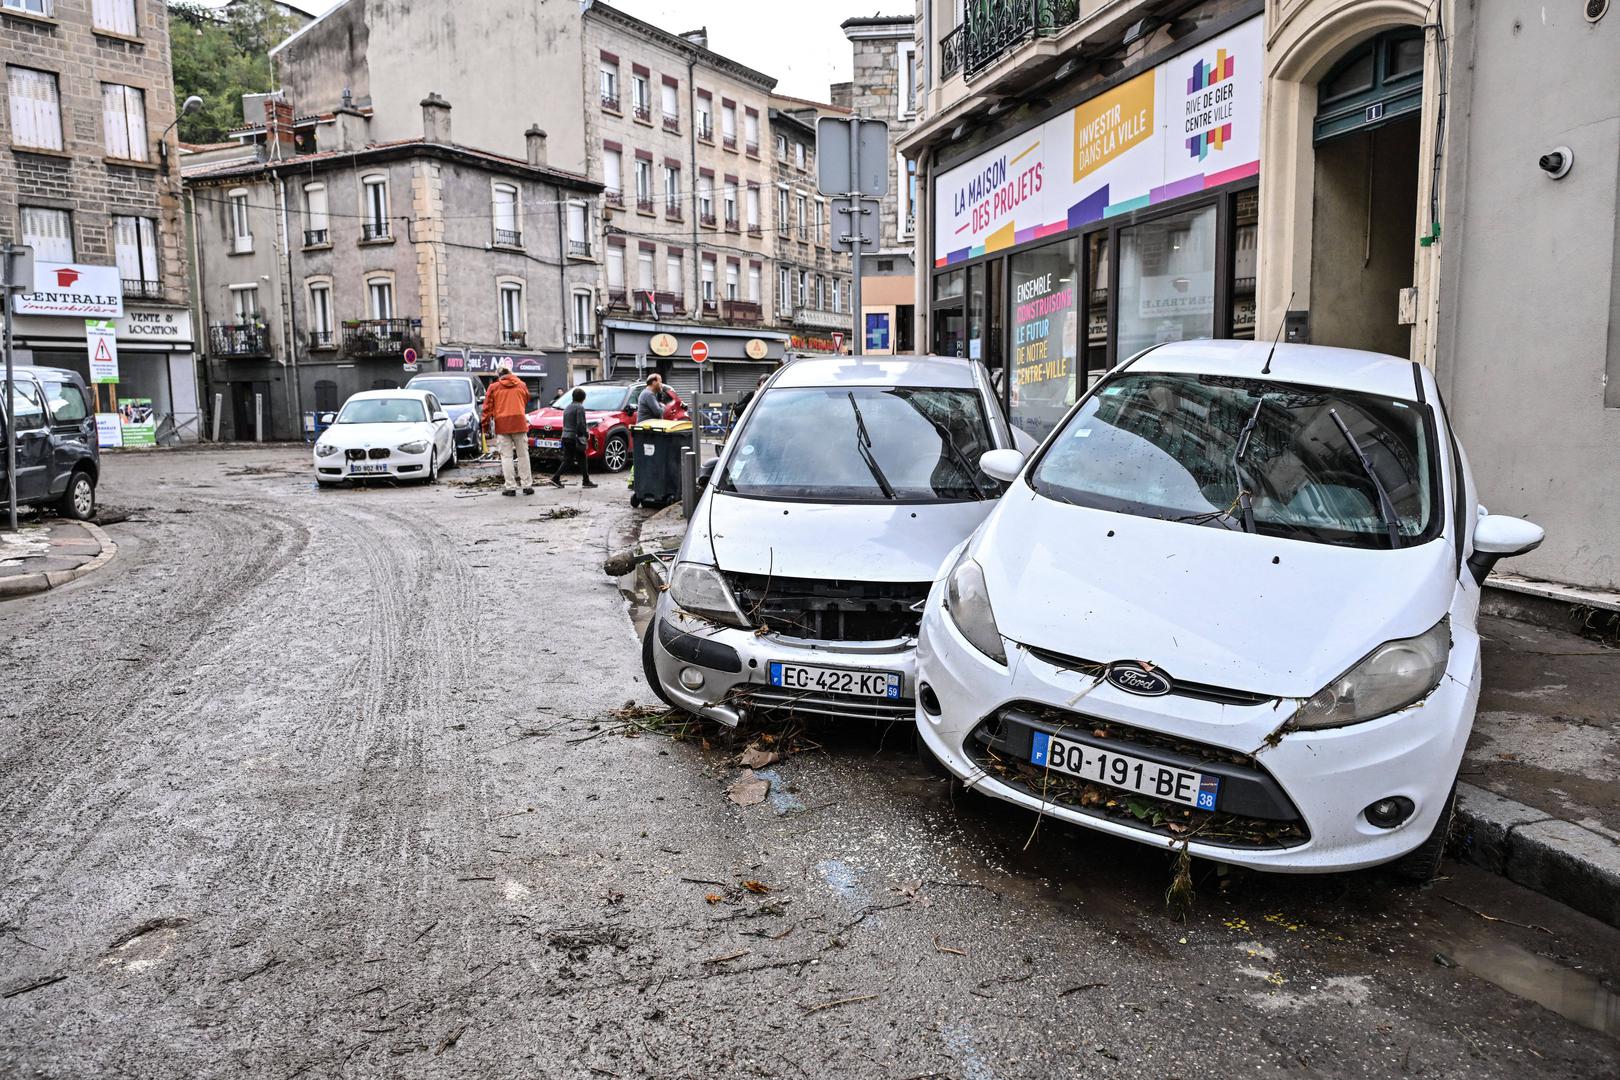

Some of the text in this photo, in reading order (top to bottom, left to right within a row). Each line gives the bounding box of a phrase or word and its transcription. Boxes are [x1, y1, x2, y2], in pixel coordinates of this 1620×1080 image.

[1186, 83, 1233, 116] RIVE DE GIER
[1371, 107, 1376, 119] 1
[1080, 104, 1120, 149] INVESTIR
[1185, 101, 1233, 133] CENTRE VILLE
[1080, 109, 1147, 171] DANS LA VILLE
[954, 154, 1007, 217] LA MAISON
[972, 161, 1043, 235] DES PROJETS
[21, 291, 118, 306] CENTRALE
[1017, 273, 1052, 303] ENSEMBLE
[22, 302, 118, 314] immobilière
[130, 312, 161, 323] VENTE
[1016, 287, 1073, 324] CONSTRUISONS
[129, 324, 178, 335] LOCATION
[1016, 318, 1050, 345] LE FUTUR
[447, 358, 464, 368] AUTO
[1016, 340, 1048, 365] DE NOTRE
[1016, 358, 1067, 385] CENTRE-VILLE
[784, 667, 886, 695] EC-422-KC
[888, 686, 898, 697] 59
[1119, 669, 1156, 691] Ford
[1036, 751, 1043, 760] F
[1049, 741, 1195, 803] BQ-191-BE
[1199, 793, 1213, 807] 38
